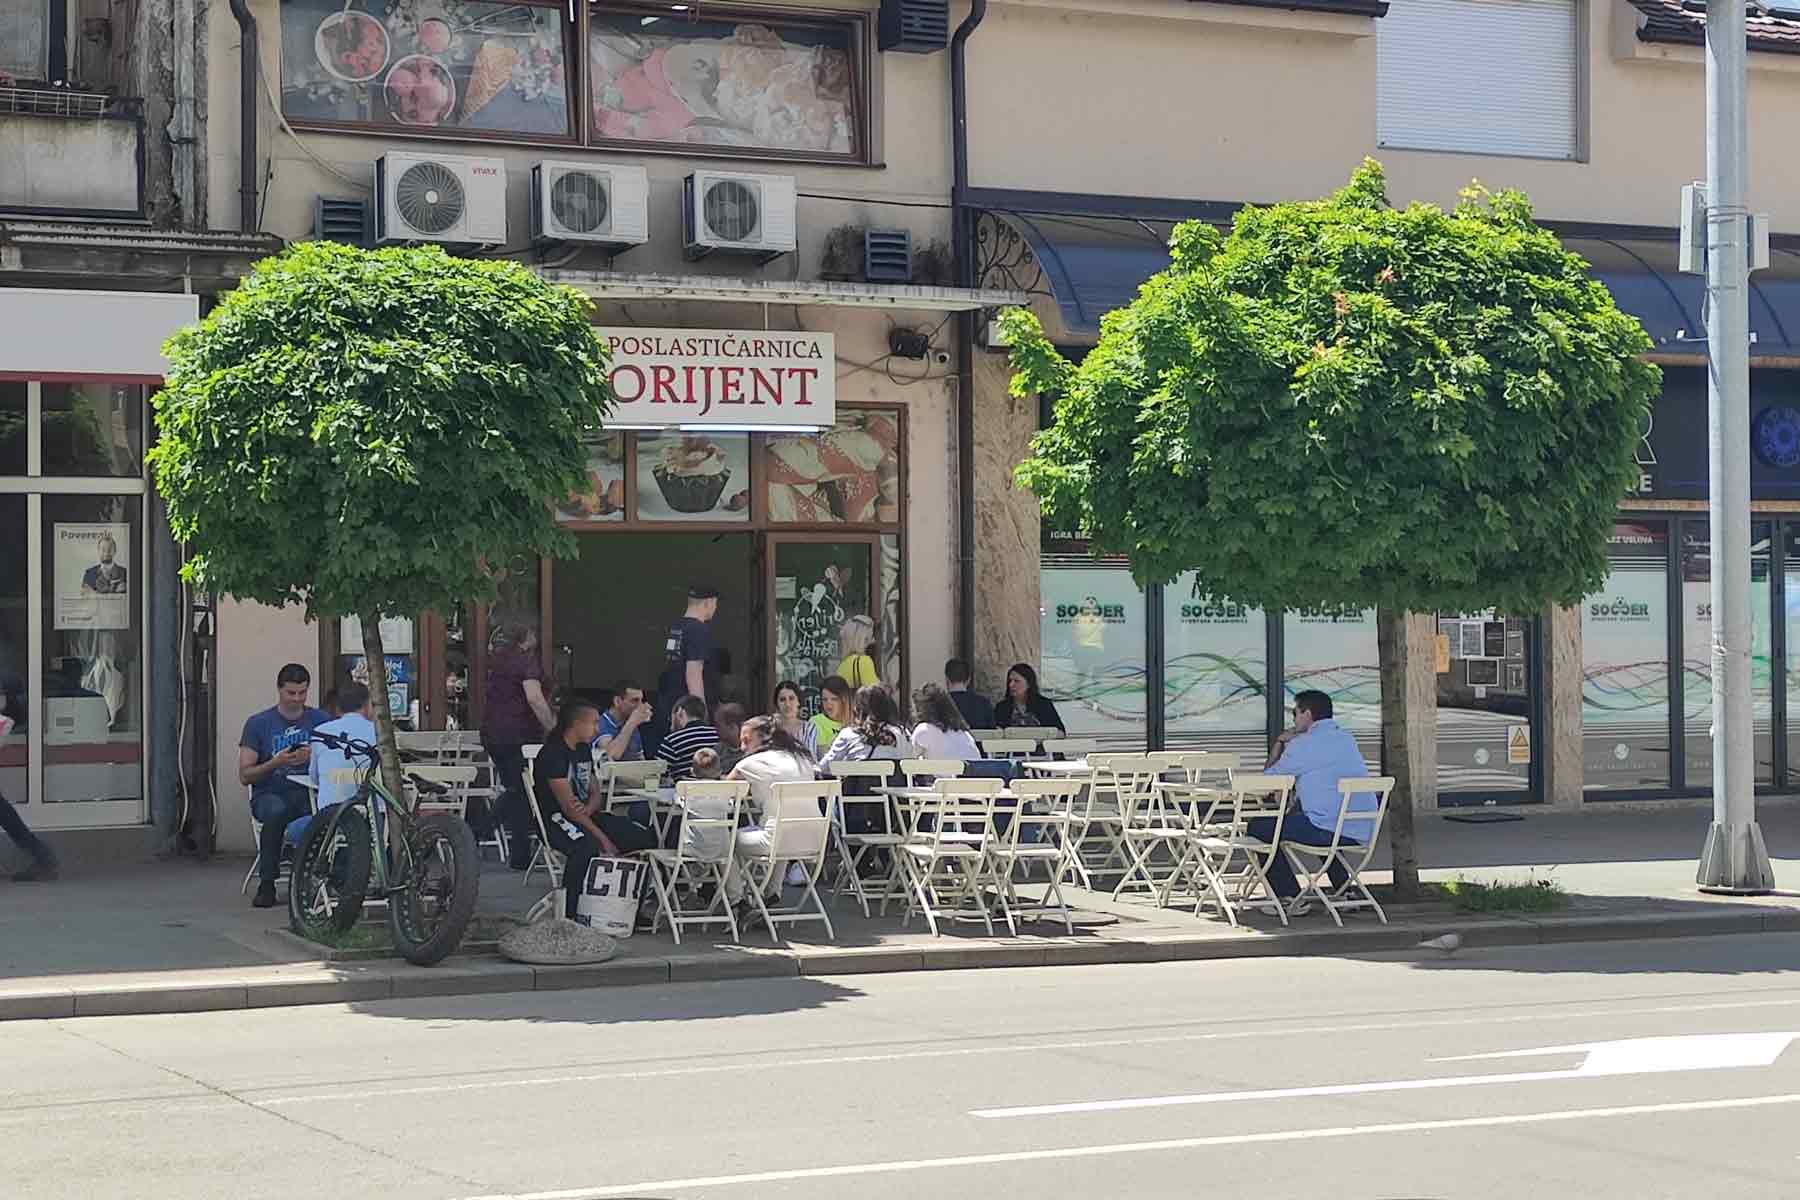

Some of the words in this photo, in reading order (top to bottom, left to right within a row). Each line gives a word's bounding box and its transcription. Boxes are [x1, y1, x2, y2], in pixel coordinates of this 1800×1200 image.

[609, 334, 822, 358] POSLASTIČARNICA
[608, 364, 818, 416] ORIJENT
[1056, 605, 1125, 618] SOCCER
[1181, 605, 1247, 618] SOCCER
[1591, 604, 1649, 617] SOCCER
